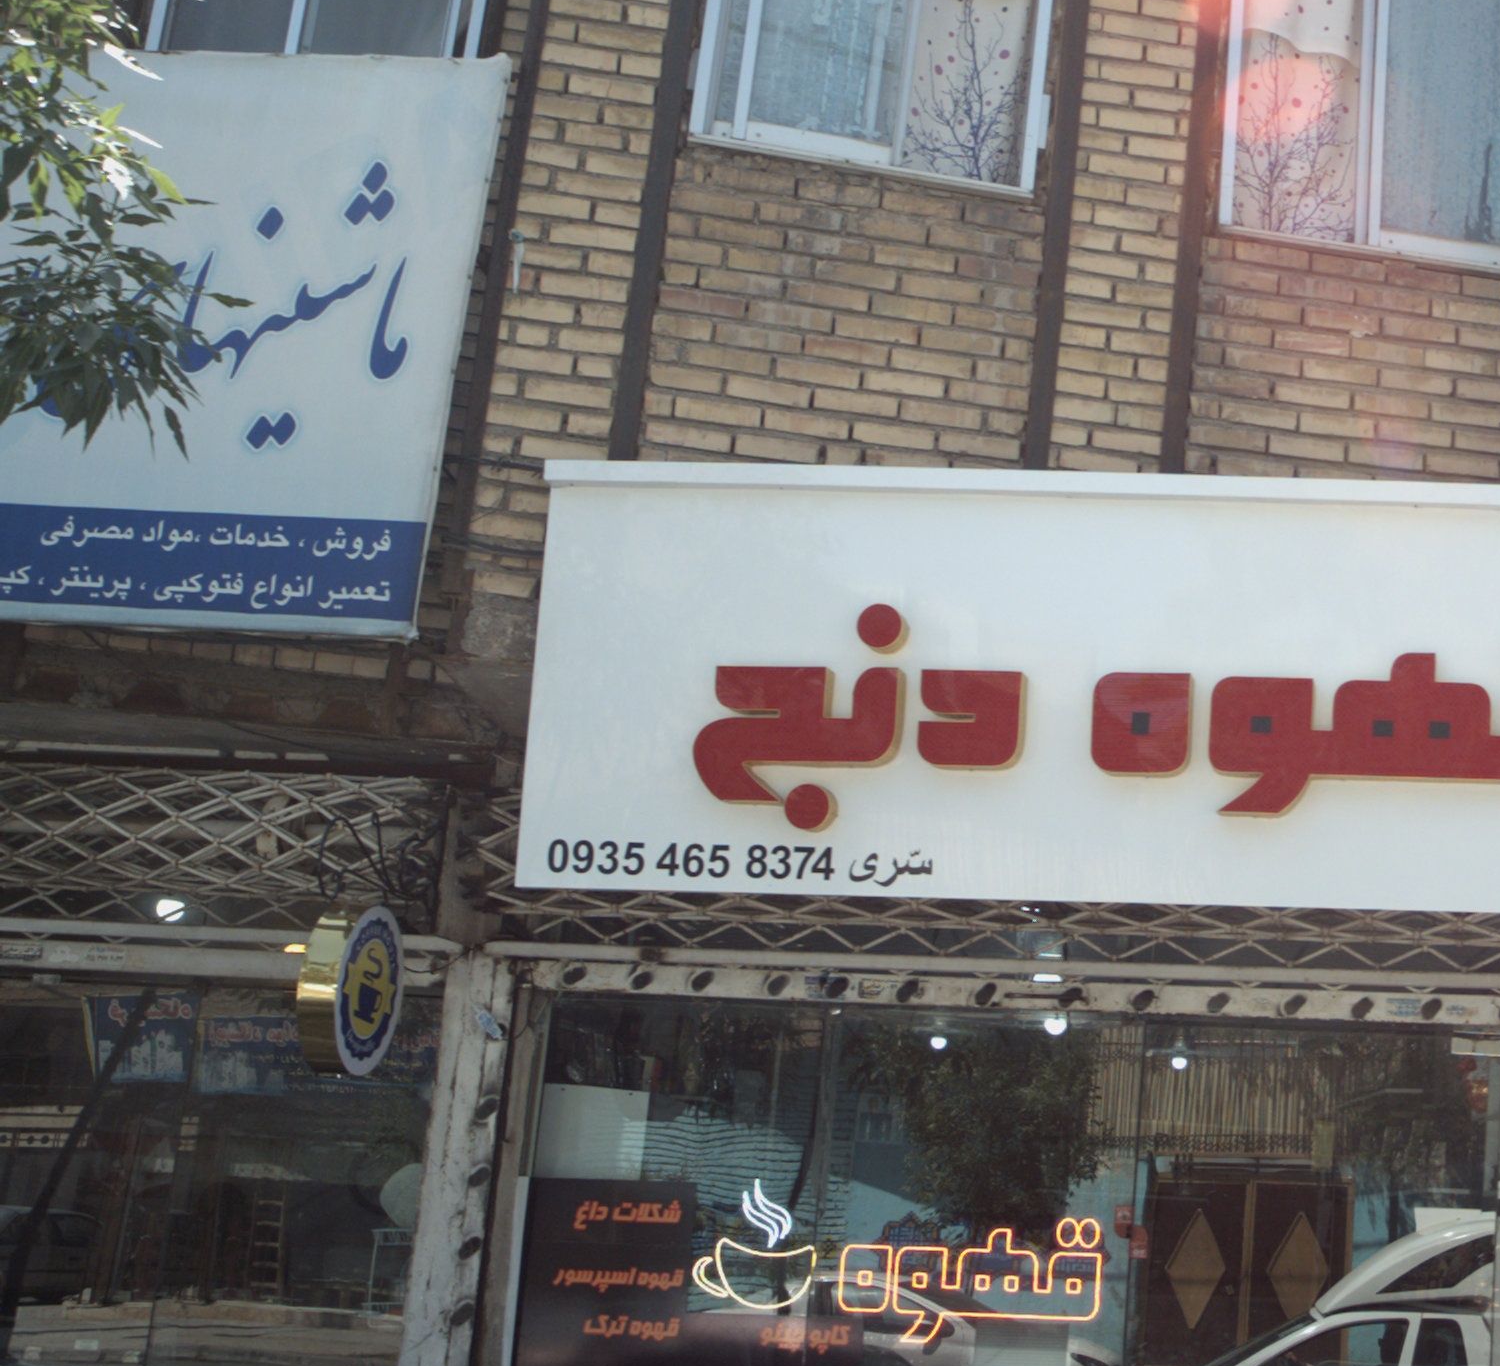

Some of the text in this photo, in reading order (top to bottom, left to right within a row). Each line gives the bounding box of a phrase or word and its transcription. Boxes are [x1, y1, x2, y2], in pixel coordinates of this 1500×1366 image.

[40, 515, 134, 548] مصرفی
[250, 574, 313, 610] انواع
[318, 581, 391, 611] تعمیر
[693, 603, 1026, 833] دنج
[547, 838, 646, 876] 0935
[655, 841, 731, 879] 465
[744, 843, 836, 882] 8374
[572, 1199, 682, 1232] شکلات داغ
[637, 1267, 685, 1291] قهوه
[837, 1217, 1103, 1344] قهوه
[582, 1313, 681, 1341] قهوه ترک
